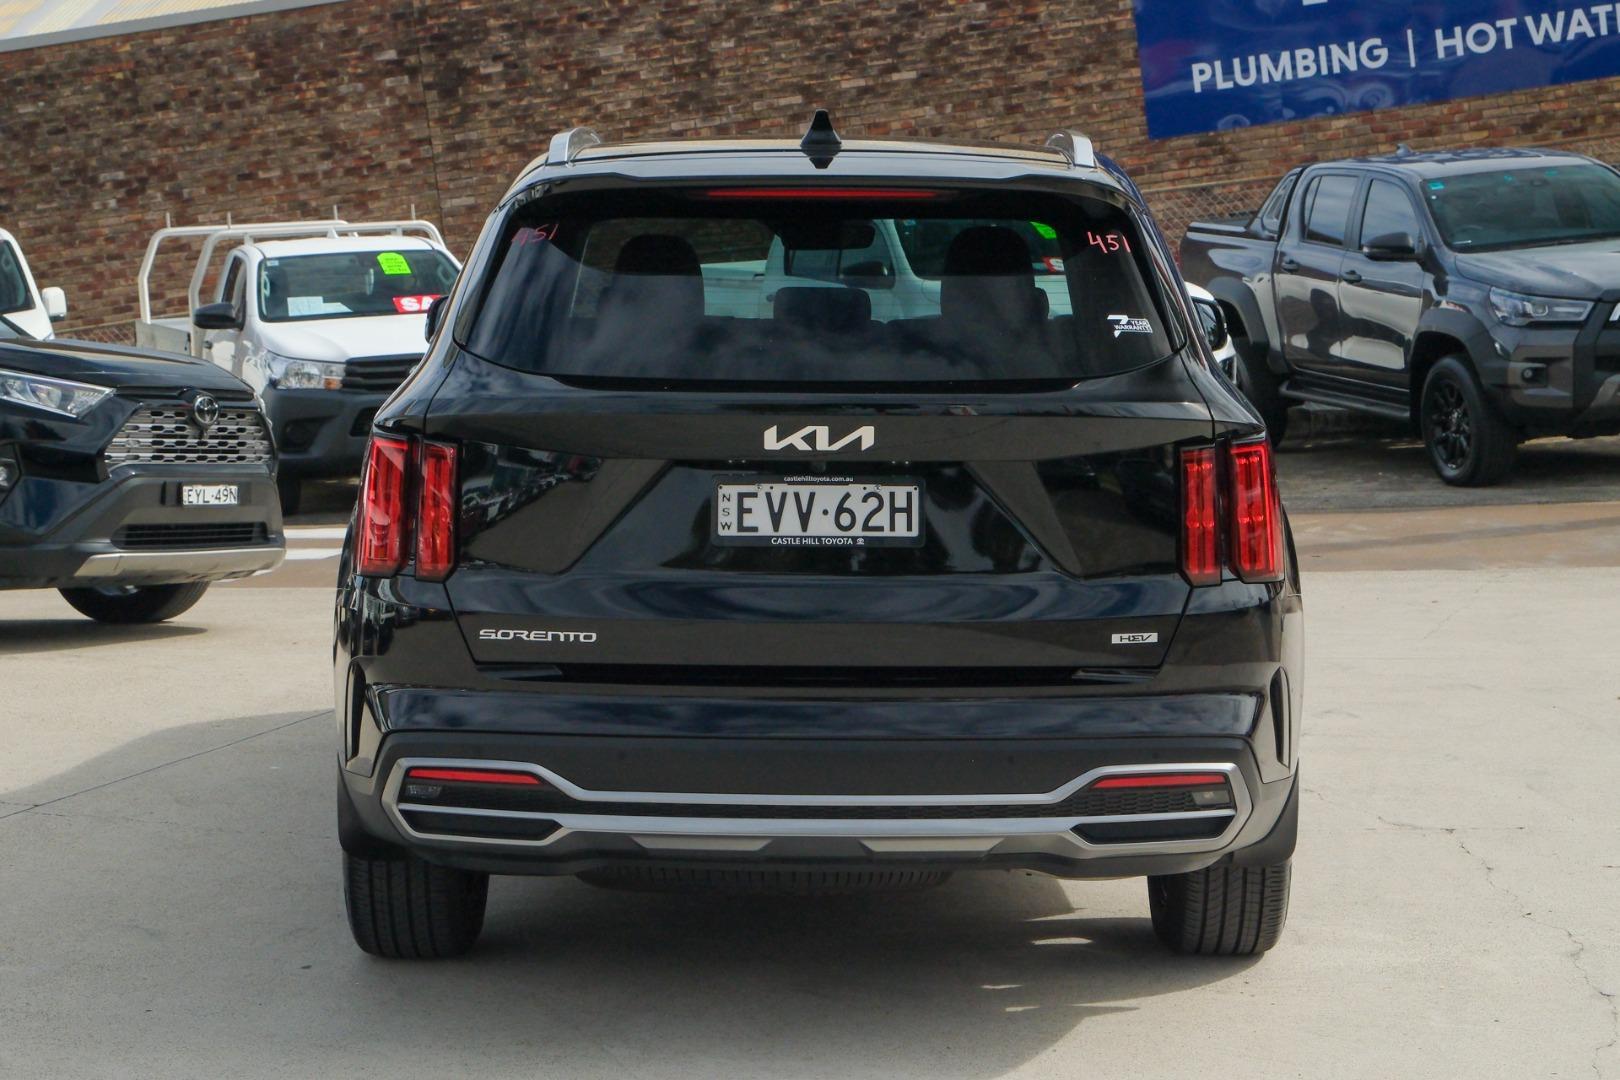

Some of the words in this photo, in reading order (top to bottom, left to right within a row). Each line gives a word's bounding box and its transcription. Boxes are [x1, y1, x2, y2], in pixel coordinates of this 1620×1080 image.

[1191, 37, 1389, 93] PLUMBING
[1434, 17, 1518, 59] HOT
[1523, 2, 1620, 46] WAT
[763, 425, 875, 451] KIA
[783, 475, 854, 485] castlehilltoyota.com.au
[771, 537, 801, 545] CASTLE
[802, 537, 820, 545] HILL
[821, 537, 854, 545] TOYOTA
[479, 629, 597, 643] SORENTO
[1119, 634, 1152, 642] HEV
